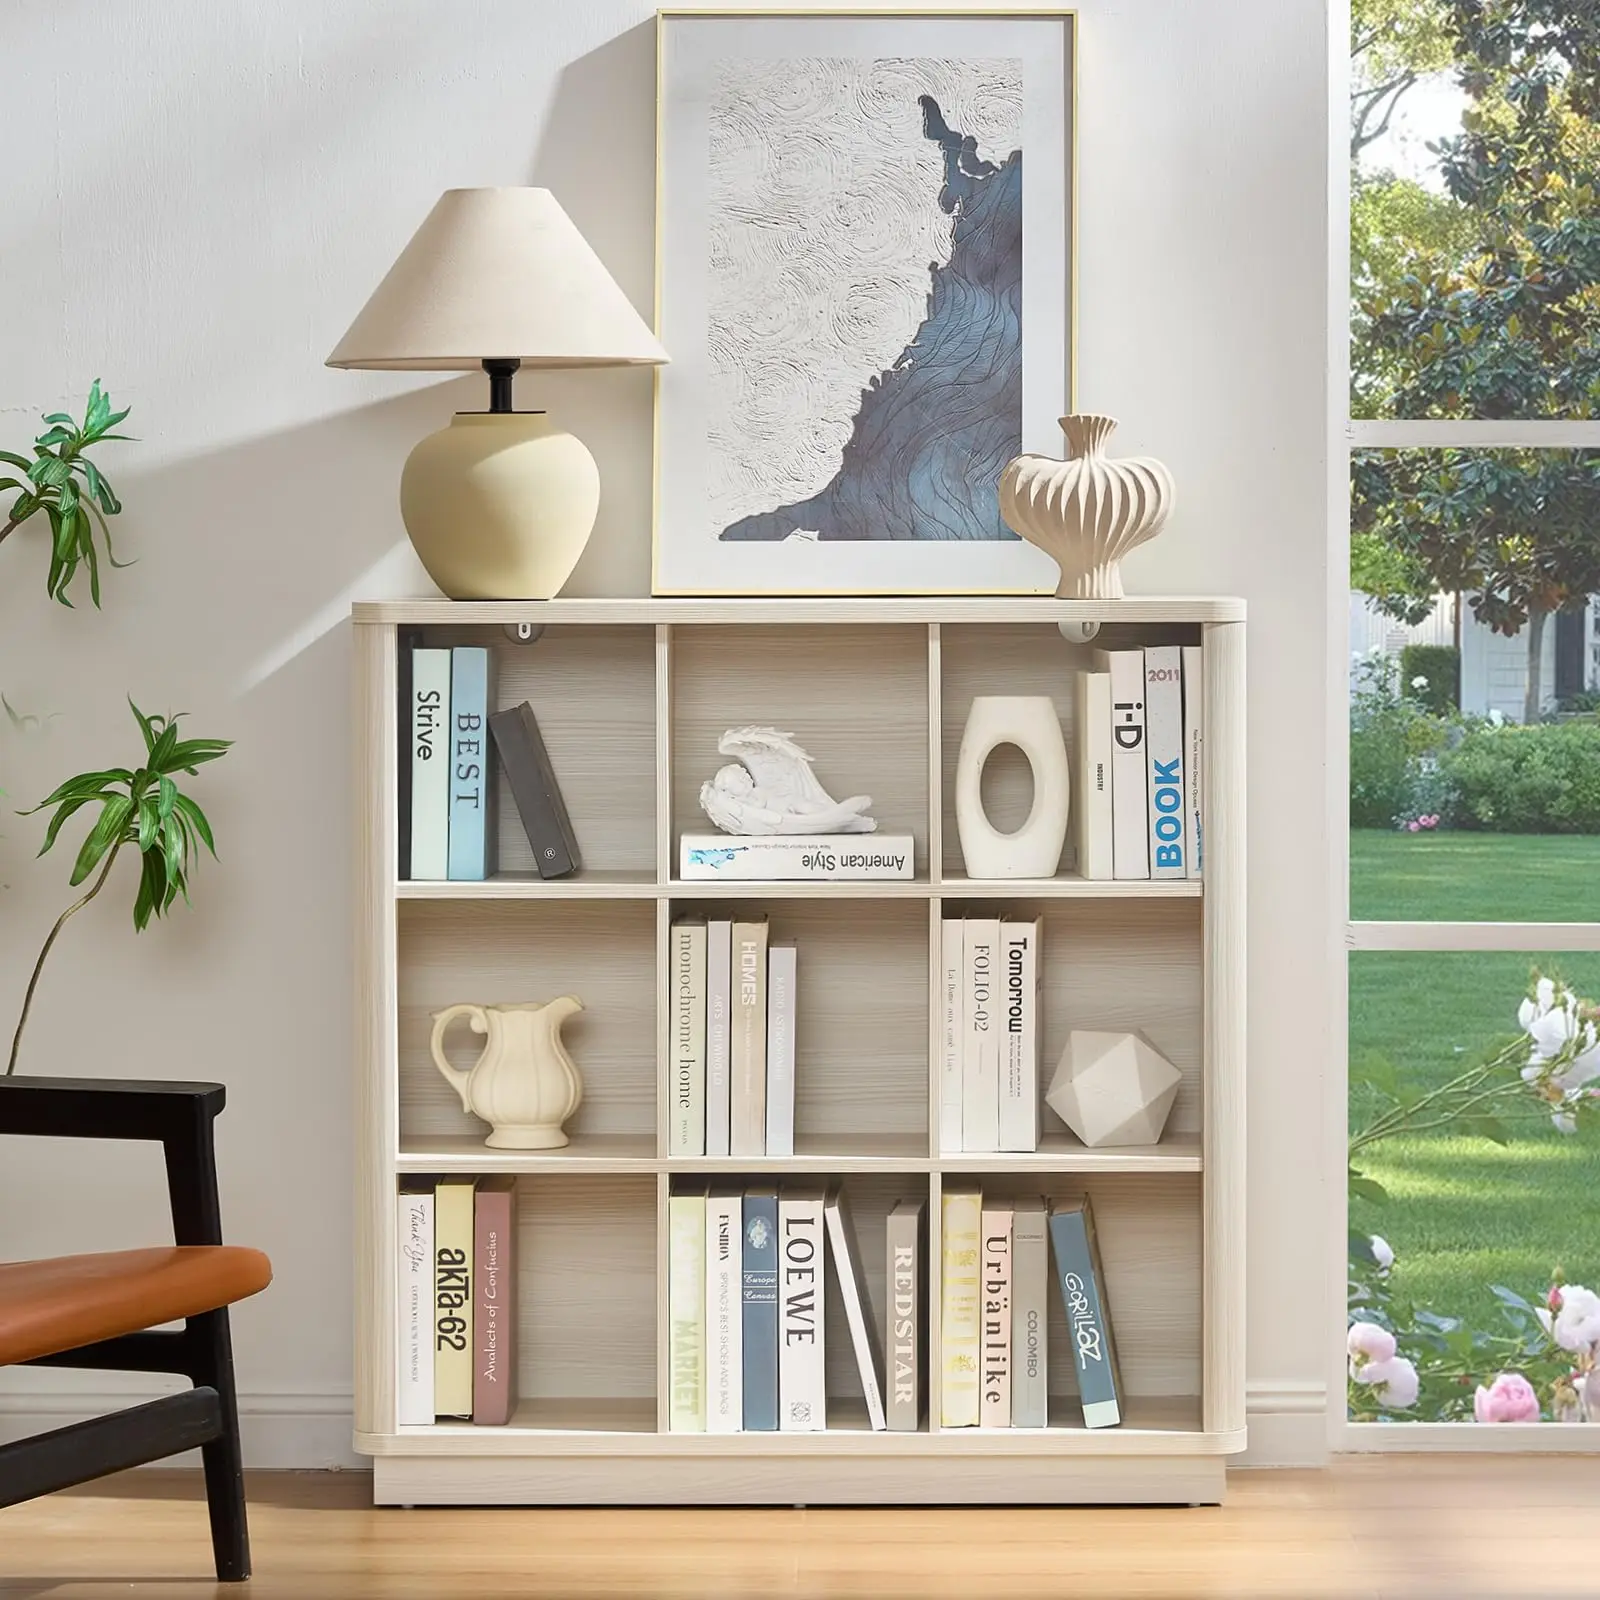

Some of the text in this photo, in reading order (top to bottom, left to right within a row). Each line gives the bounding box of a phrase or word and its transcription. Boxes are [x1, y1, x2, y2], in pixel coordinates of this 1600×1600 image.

[1148, 668, 1179, 682] 2011
[416, 690, 440, 761] Strive
[1114, 702, 1143, 749] i-D
[455, 712, 481, 809] BEST
[1153, 758, 1182, 868] BOOK
[802, 851, 905, 871] American Style
[679, 934, 696, 1052] monochrome
[741, 941, 758, 1006] HOMES
[974, 944, 990, 1032] FOLIO-02
[1007, 937, 1028, 1033] Tomorrow
[679, 1059, 696, 1108] home
[410, 1204, 425, 1242] Thank
[719, 1214, 729, 1262] FASHION
[404, 1243, 425, 1273] You
[786, 1217, 815, 1347] LOEWE
[483, 1232, 499, 1383] Analects of Confucius
[719, 1314, 729, 1334] BEST
[894, 1246, 913, 1405] REDSTAR
[986, 1235, 1009, 1404] Urbänlike
[674, 1320, 698, 1416] MARKET
[719, 1335, 729, 1365] SHOES
[719, 1366, 729, 1388] AND
[1027, 1310, 1038, 1378] COLOMBO
[719, 1390, 729, 1415] BAGS
